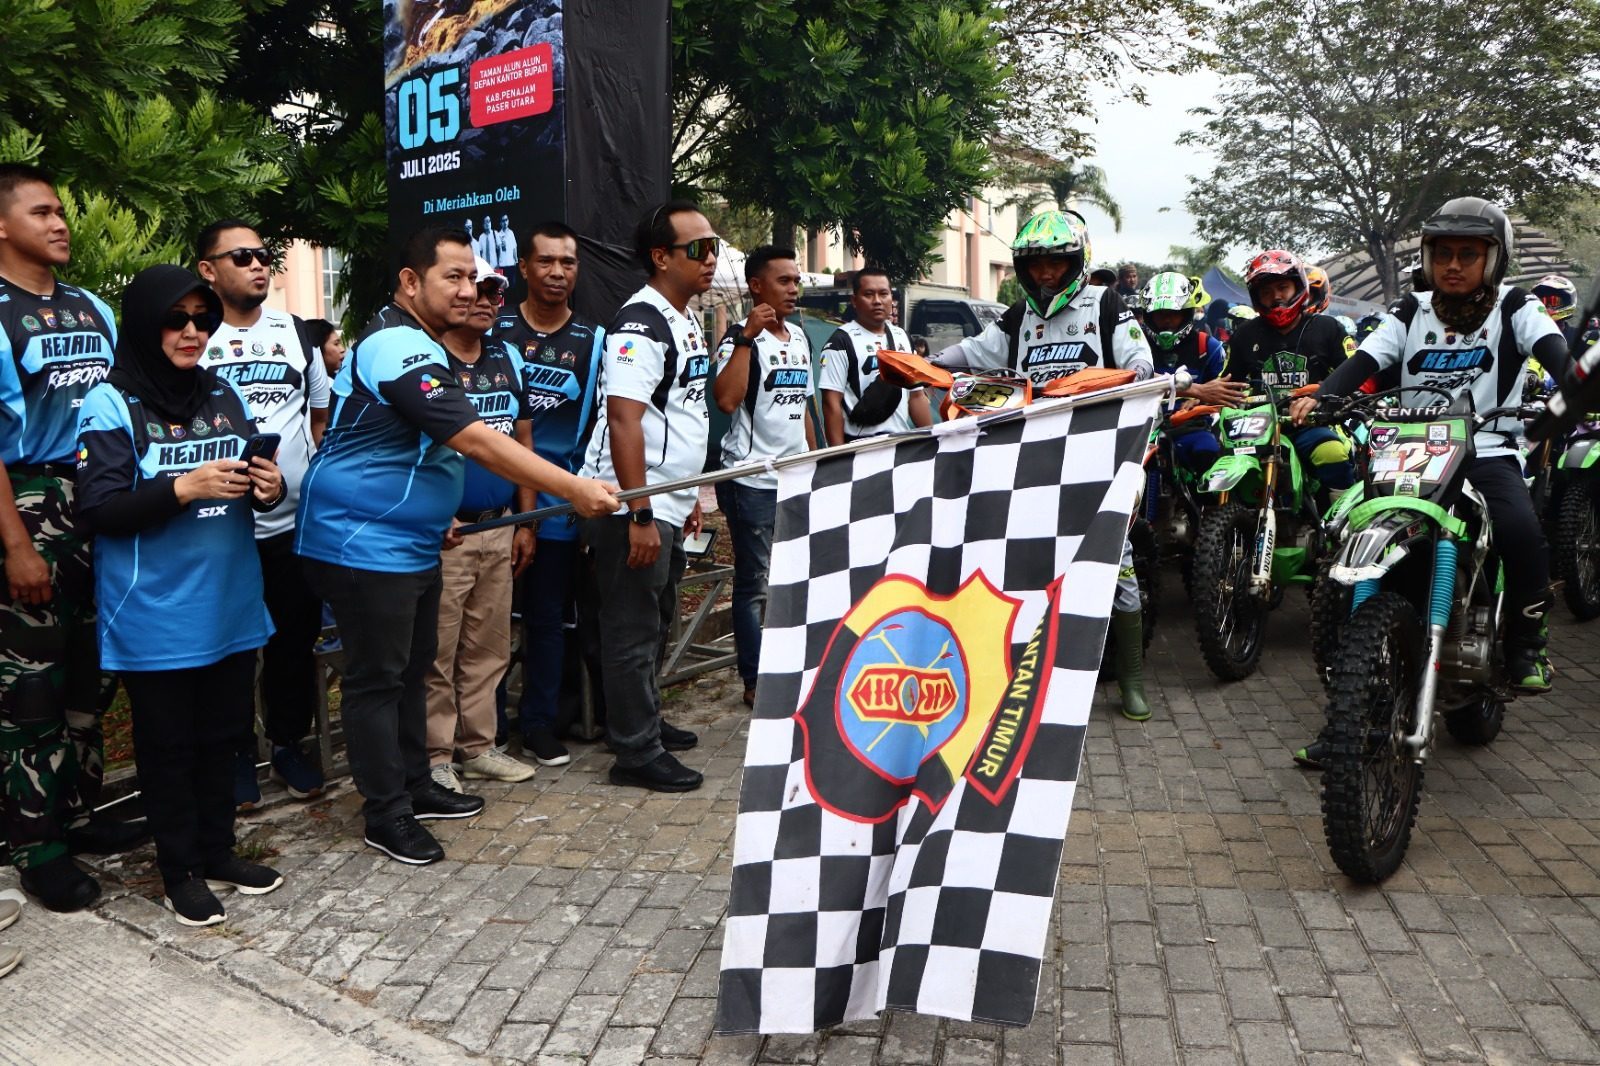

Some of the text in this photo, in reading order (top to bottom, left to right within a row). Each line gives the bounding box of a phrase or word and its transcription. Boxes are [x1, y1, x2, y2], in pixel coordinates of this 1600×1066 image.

[474, 63, 548, 90] DEPAN KANTOR BUPATI
[480, 55, 541, 78] TAMAN ALUN ALUN
[399, 68, 460, 149] 05
[486, 96, 535, 114] PASER UTARA
[400, 150, 460, 179] JULI 2025
[423, 185, 520, 214] Di Meriahkan Oleh
[621, 322, 650, 332] SIX
[41, 335, 102, 359] KEJAM
[1029, 344, 1084, 364] KEJAM
[403, 354, 432, 369] SIX
[42, 366, 110, 397] REBORN
[216, 363, 288, 383] KEJAM
[525, 365, 571, 388] JAM
[245, 391, 295, 408] BORN
[426, 387, 444, 399] adw
[470, 394, 510, 413] JAM
[1376, 407, 1448, 416] RENTHA
[1229, 417, 1265, 437] 312
[159, 438, 239, 466] KEJAM
[197, 505, 229, 518] SIX
[1263, 529, 1274, 573] DUNLOP
[977, 619, 1044, 778] ANTAN TIMUR
